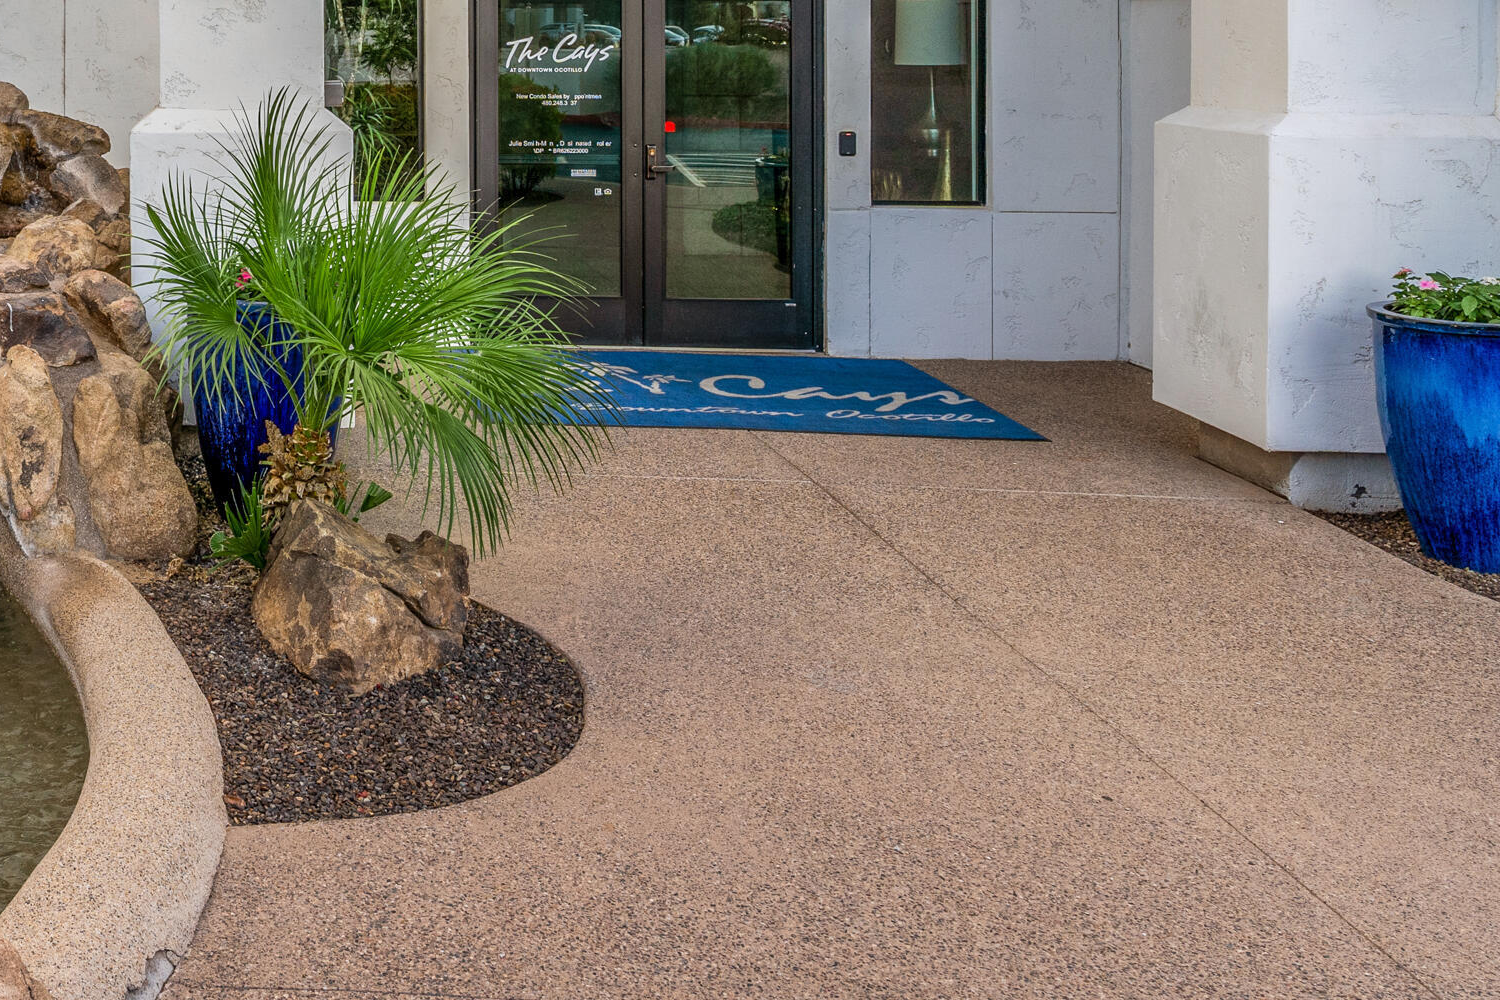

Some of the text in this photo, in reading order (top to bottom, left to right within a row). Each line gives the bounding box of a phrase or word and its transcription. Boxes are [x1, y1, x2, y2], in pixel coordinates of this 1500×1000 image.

[505, 33, 615, 73] The Cays
[699, 373, 977, 412] Cays
[826, 409, 997, 425] Ocotillo
